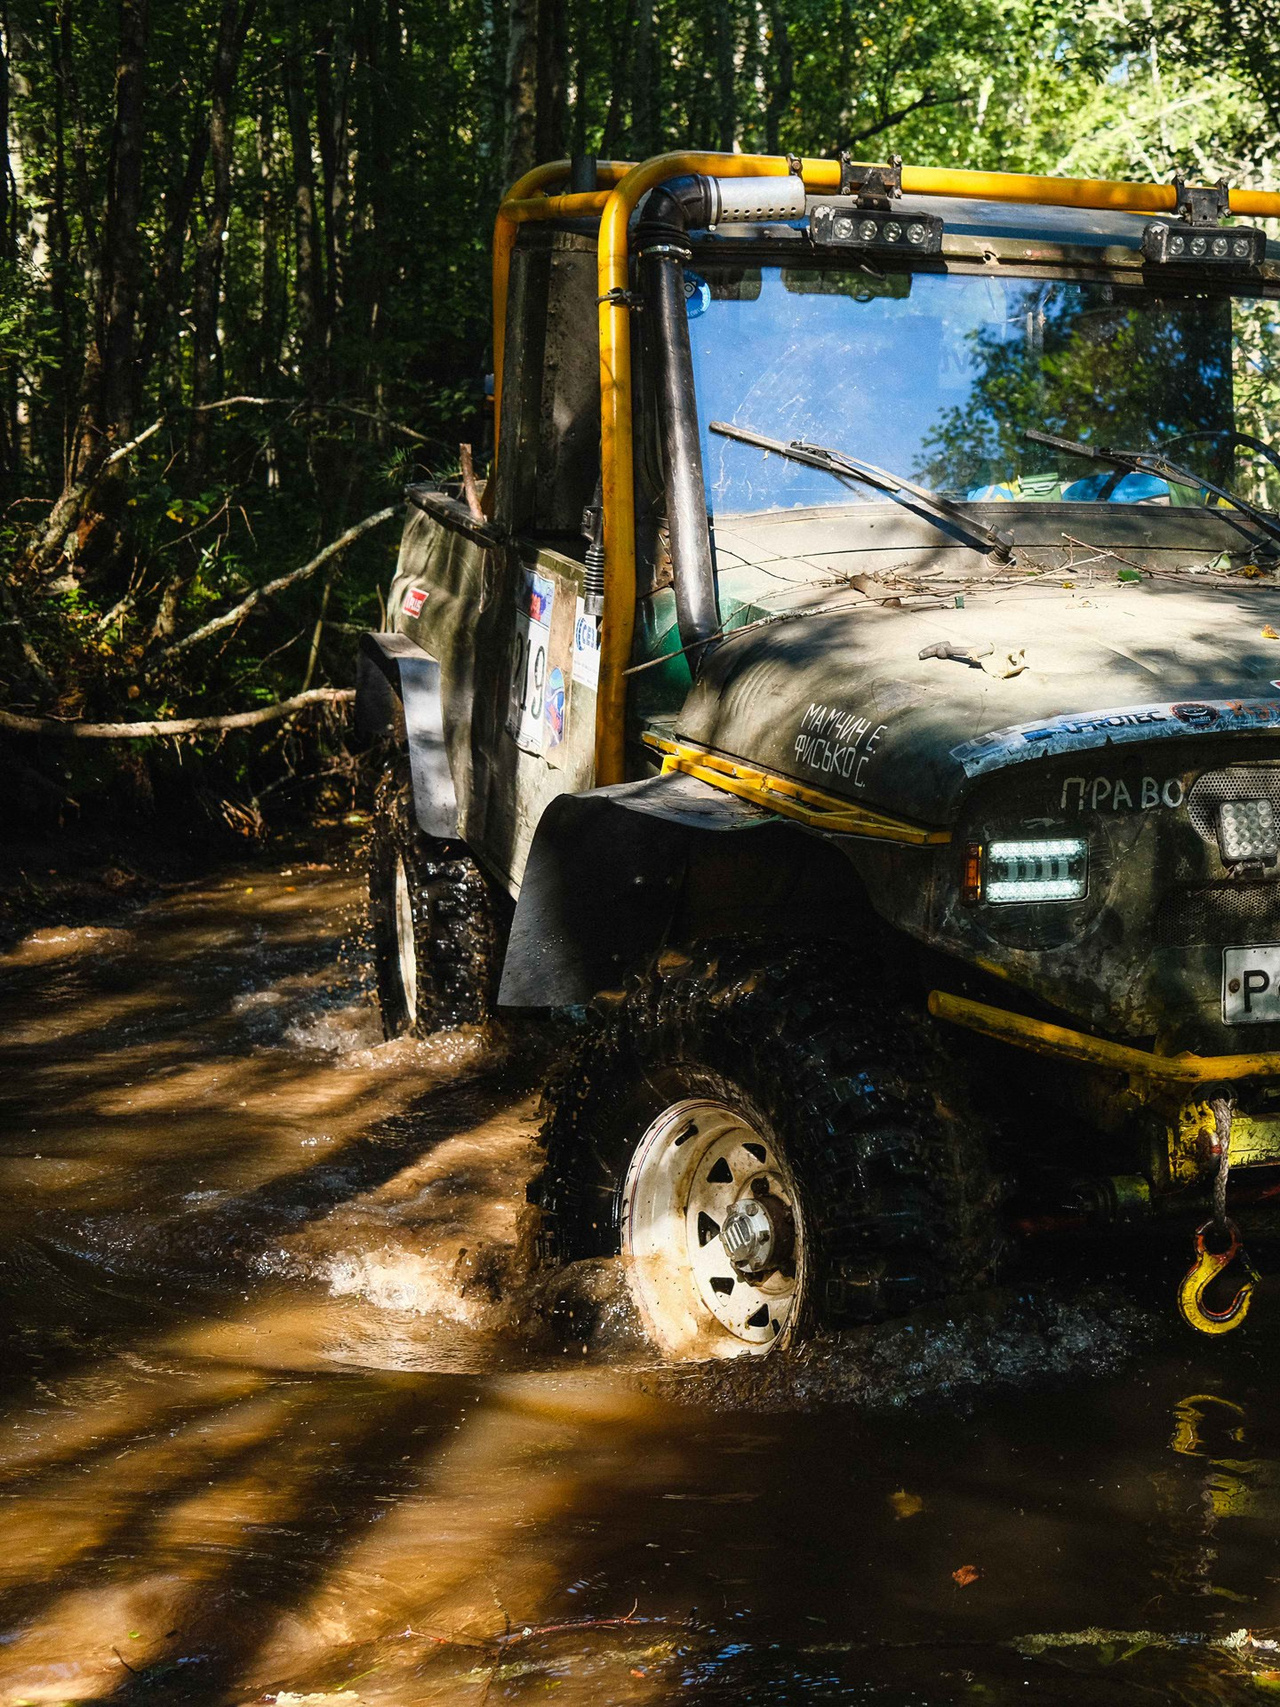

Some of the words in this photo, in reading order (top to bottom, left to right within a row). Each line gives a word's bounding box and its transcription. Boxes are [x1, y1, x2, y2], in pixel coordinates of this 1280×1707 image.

[801, 703, 872, 747] МАМЧИЧ
[795, 735, 856, 778] ФИСЬКО
[1060, 777, 1184, 810] ПРАВО
